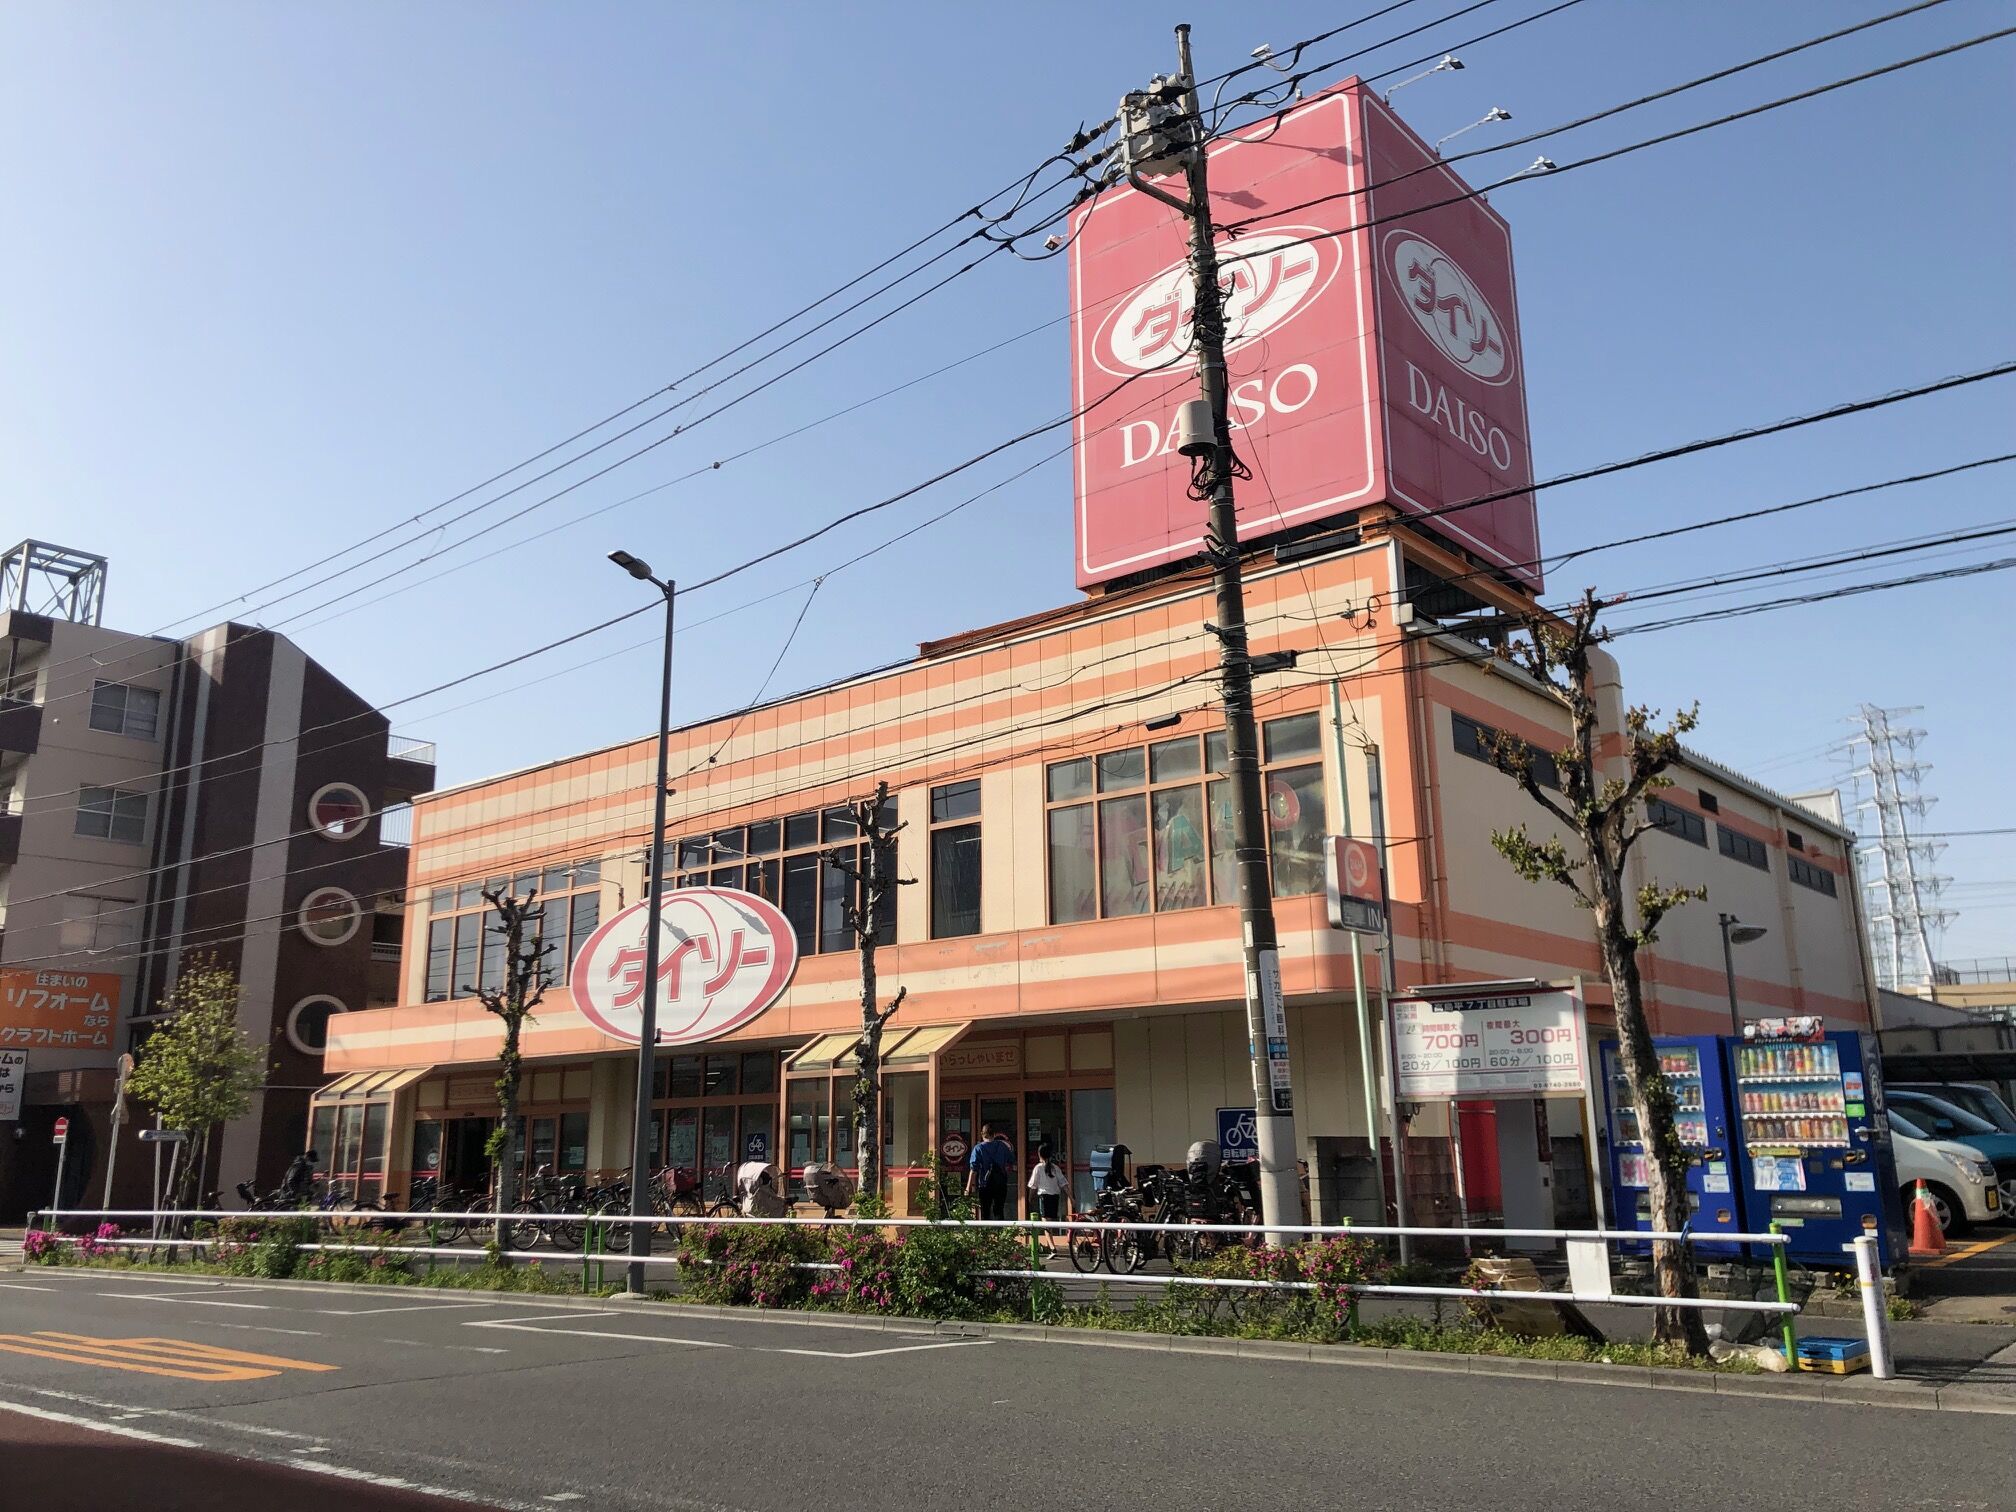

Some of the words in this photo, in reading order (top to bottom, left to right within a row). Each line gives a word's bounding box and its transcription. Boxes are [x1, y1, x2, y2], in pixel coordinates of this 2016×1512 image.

[1132, 252, 1314, 360] ダソー
[1408, 257, 1502, 358] ダイソー
[1120, 363, 1318, 469] DSO
[1406, 360, 1511, 470] DAISO
[1367, 907, 1381, 928] IN
[608, 928, 769, 1009] ダイソー
[36, 974, 88, 988] 住まいの
[7, 988, 111, 1012] リフォーム
[84, 1015, 110, 1027] なら
[0, 1026, 107, 1045] クラフトホーム
[1422, 1033, 1479, 1050] 700円
[1511, 1029, 1571, 1045] 300円
[1222, 1148, 1258, 1159] 自転車
